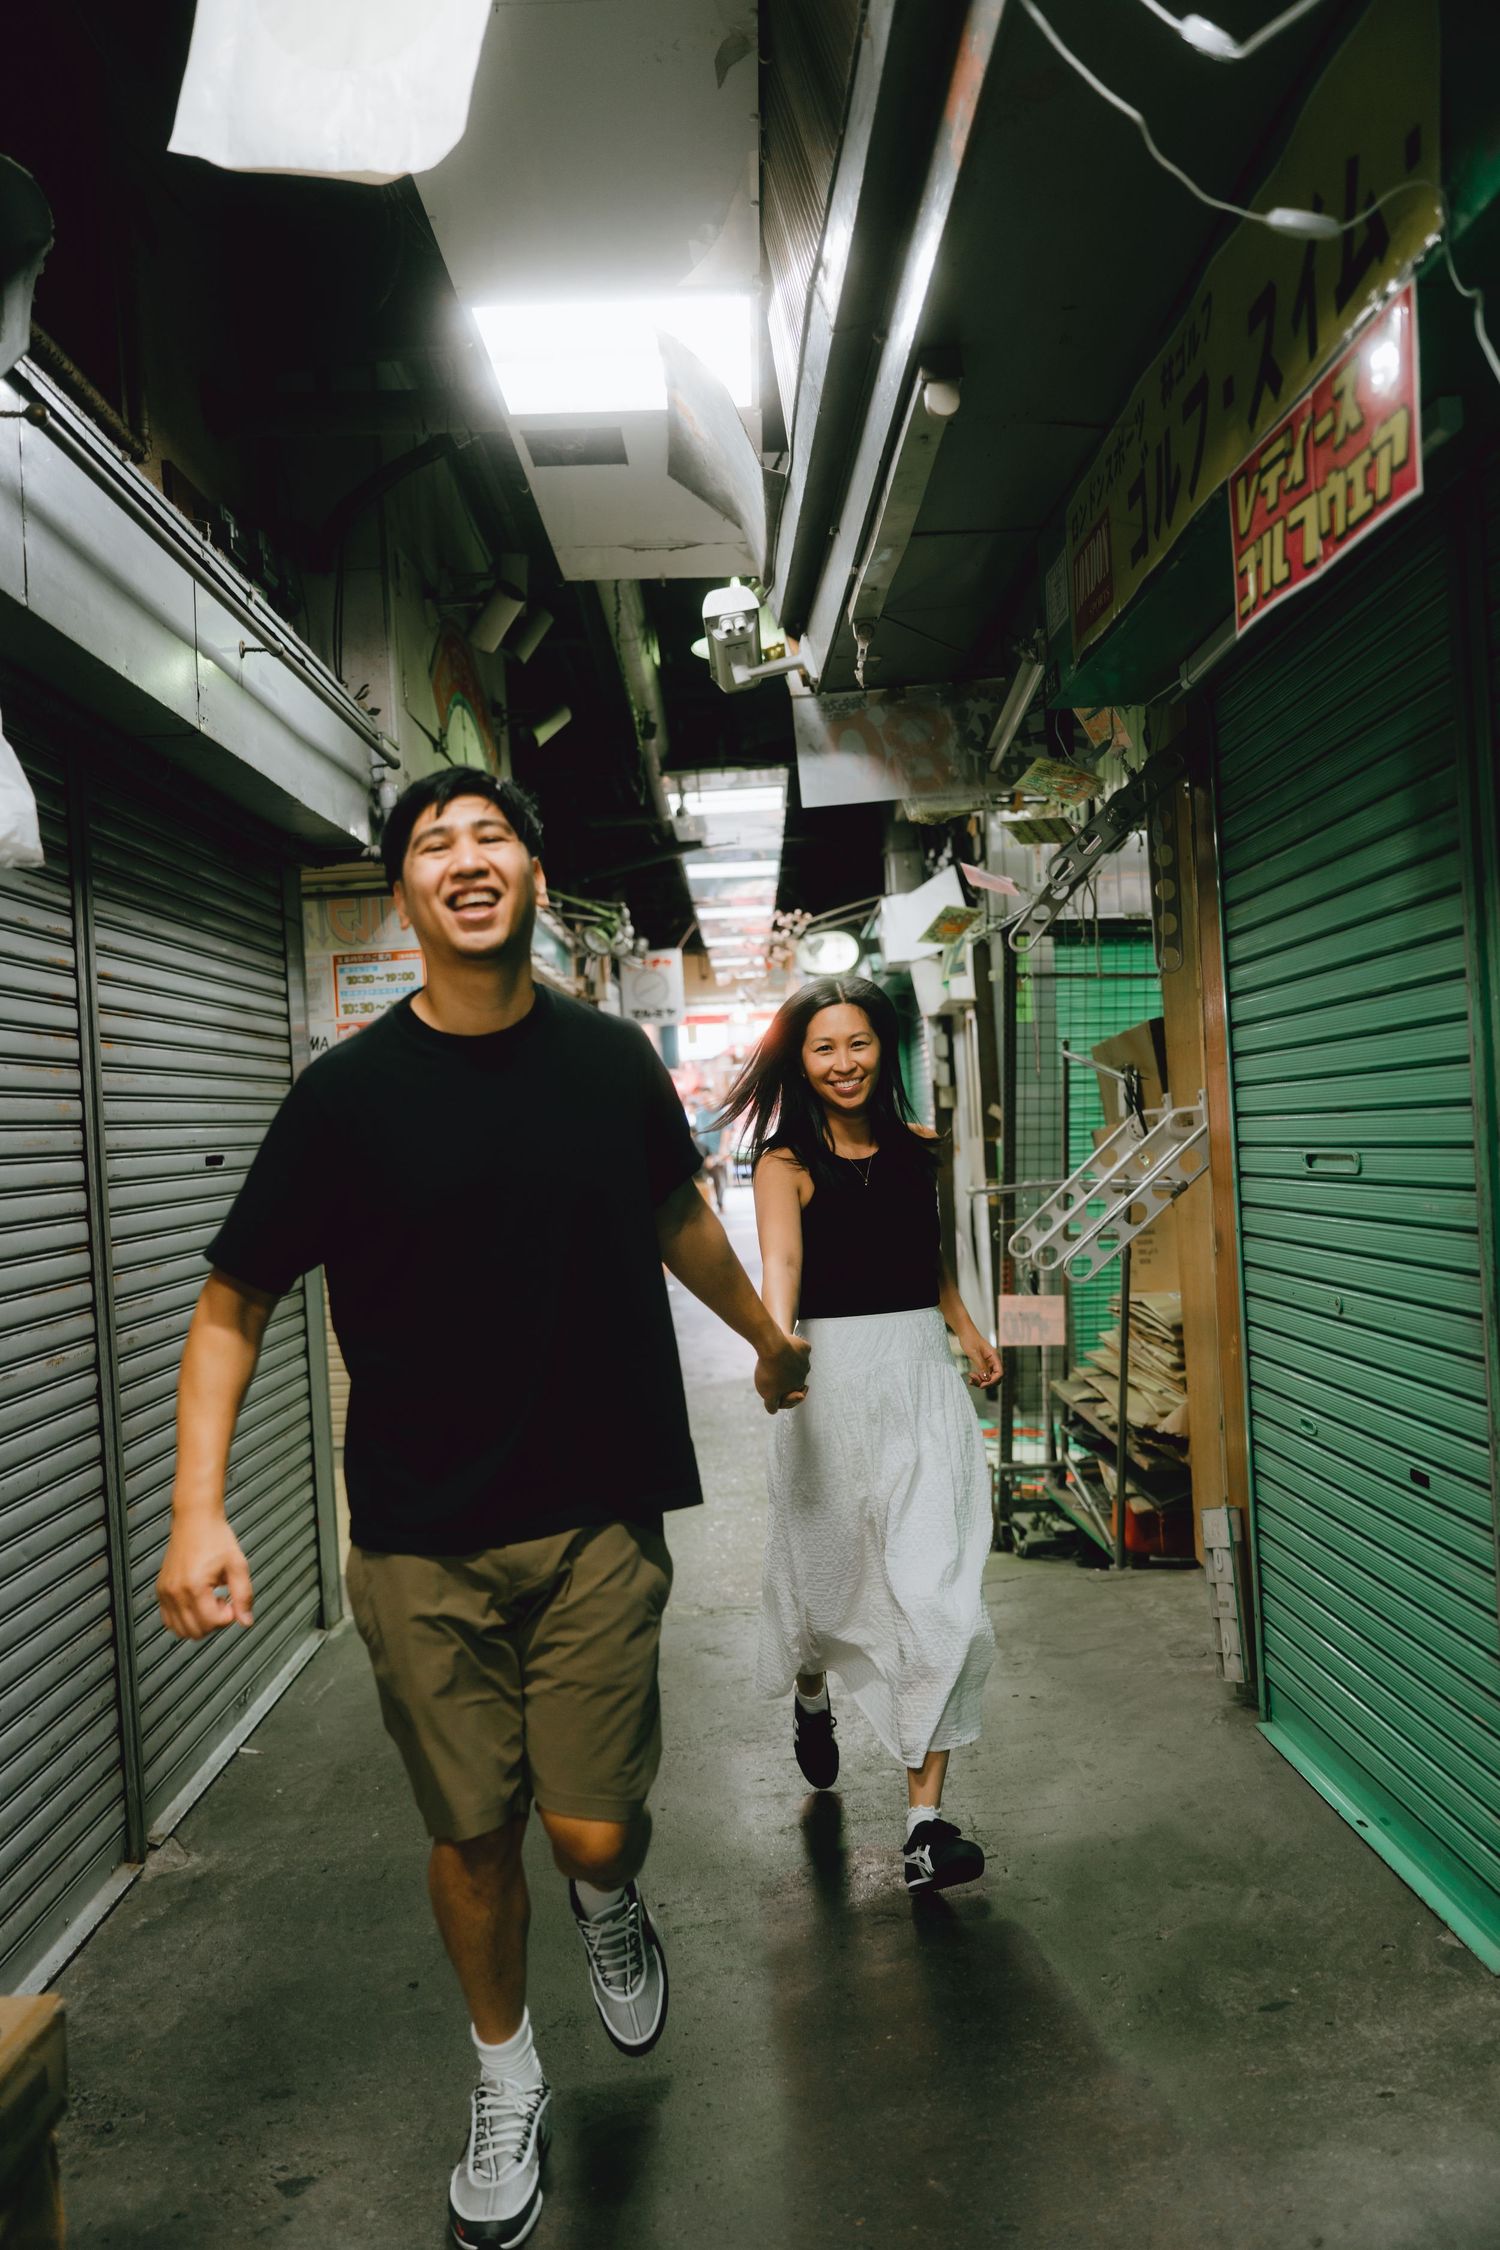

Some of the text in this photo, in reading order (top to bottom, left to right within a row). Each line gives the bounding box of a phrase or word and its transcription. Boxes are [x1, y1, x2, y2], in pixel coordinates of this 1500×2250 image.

[1072, 398, 1145, 546] ロンドンスポーツ
[1074, 514, 1110, 617] LONDON
